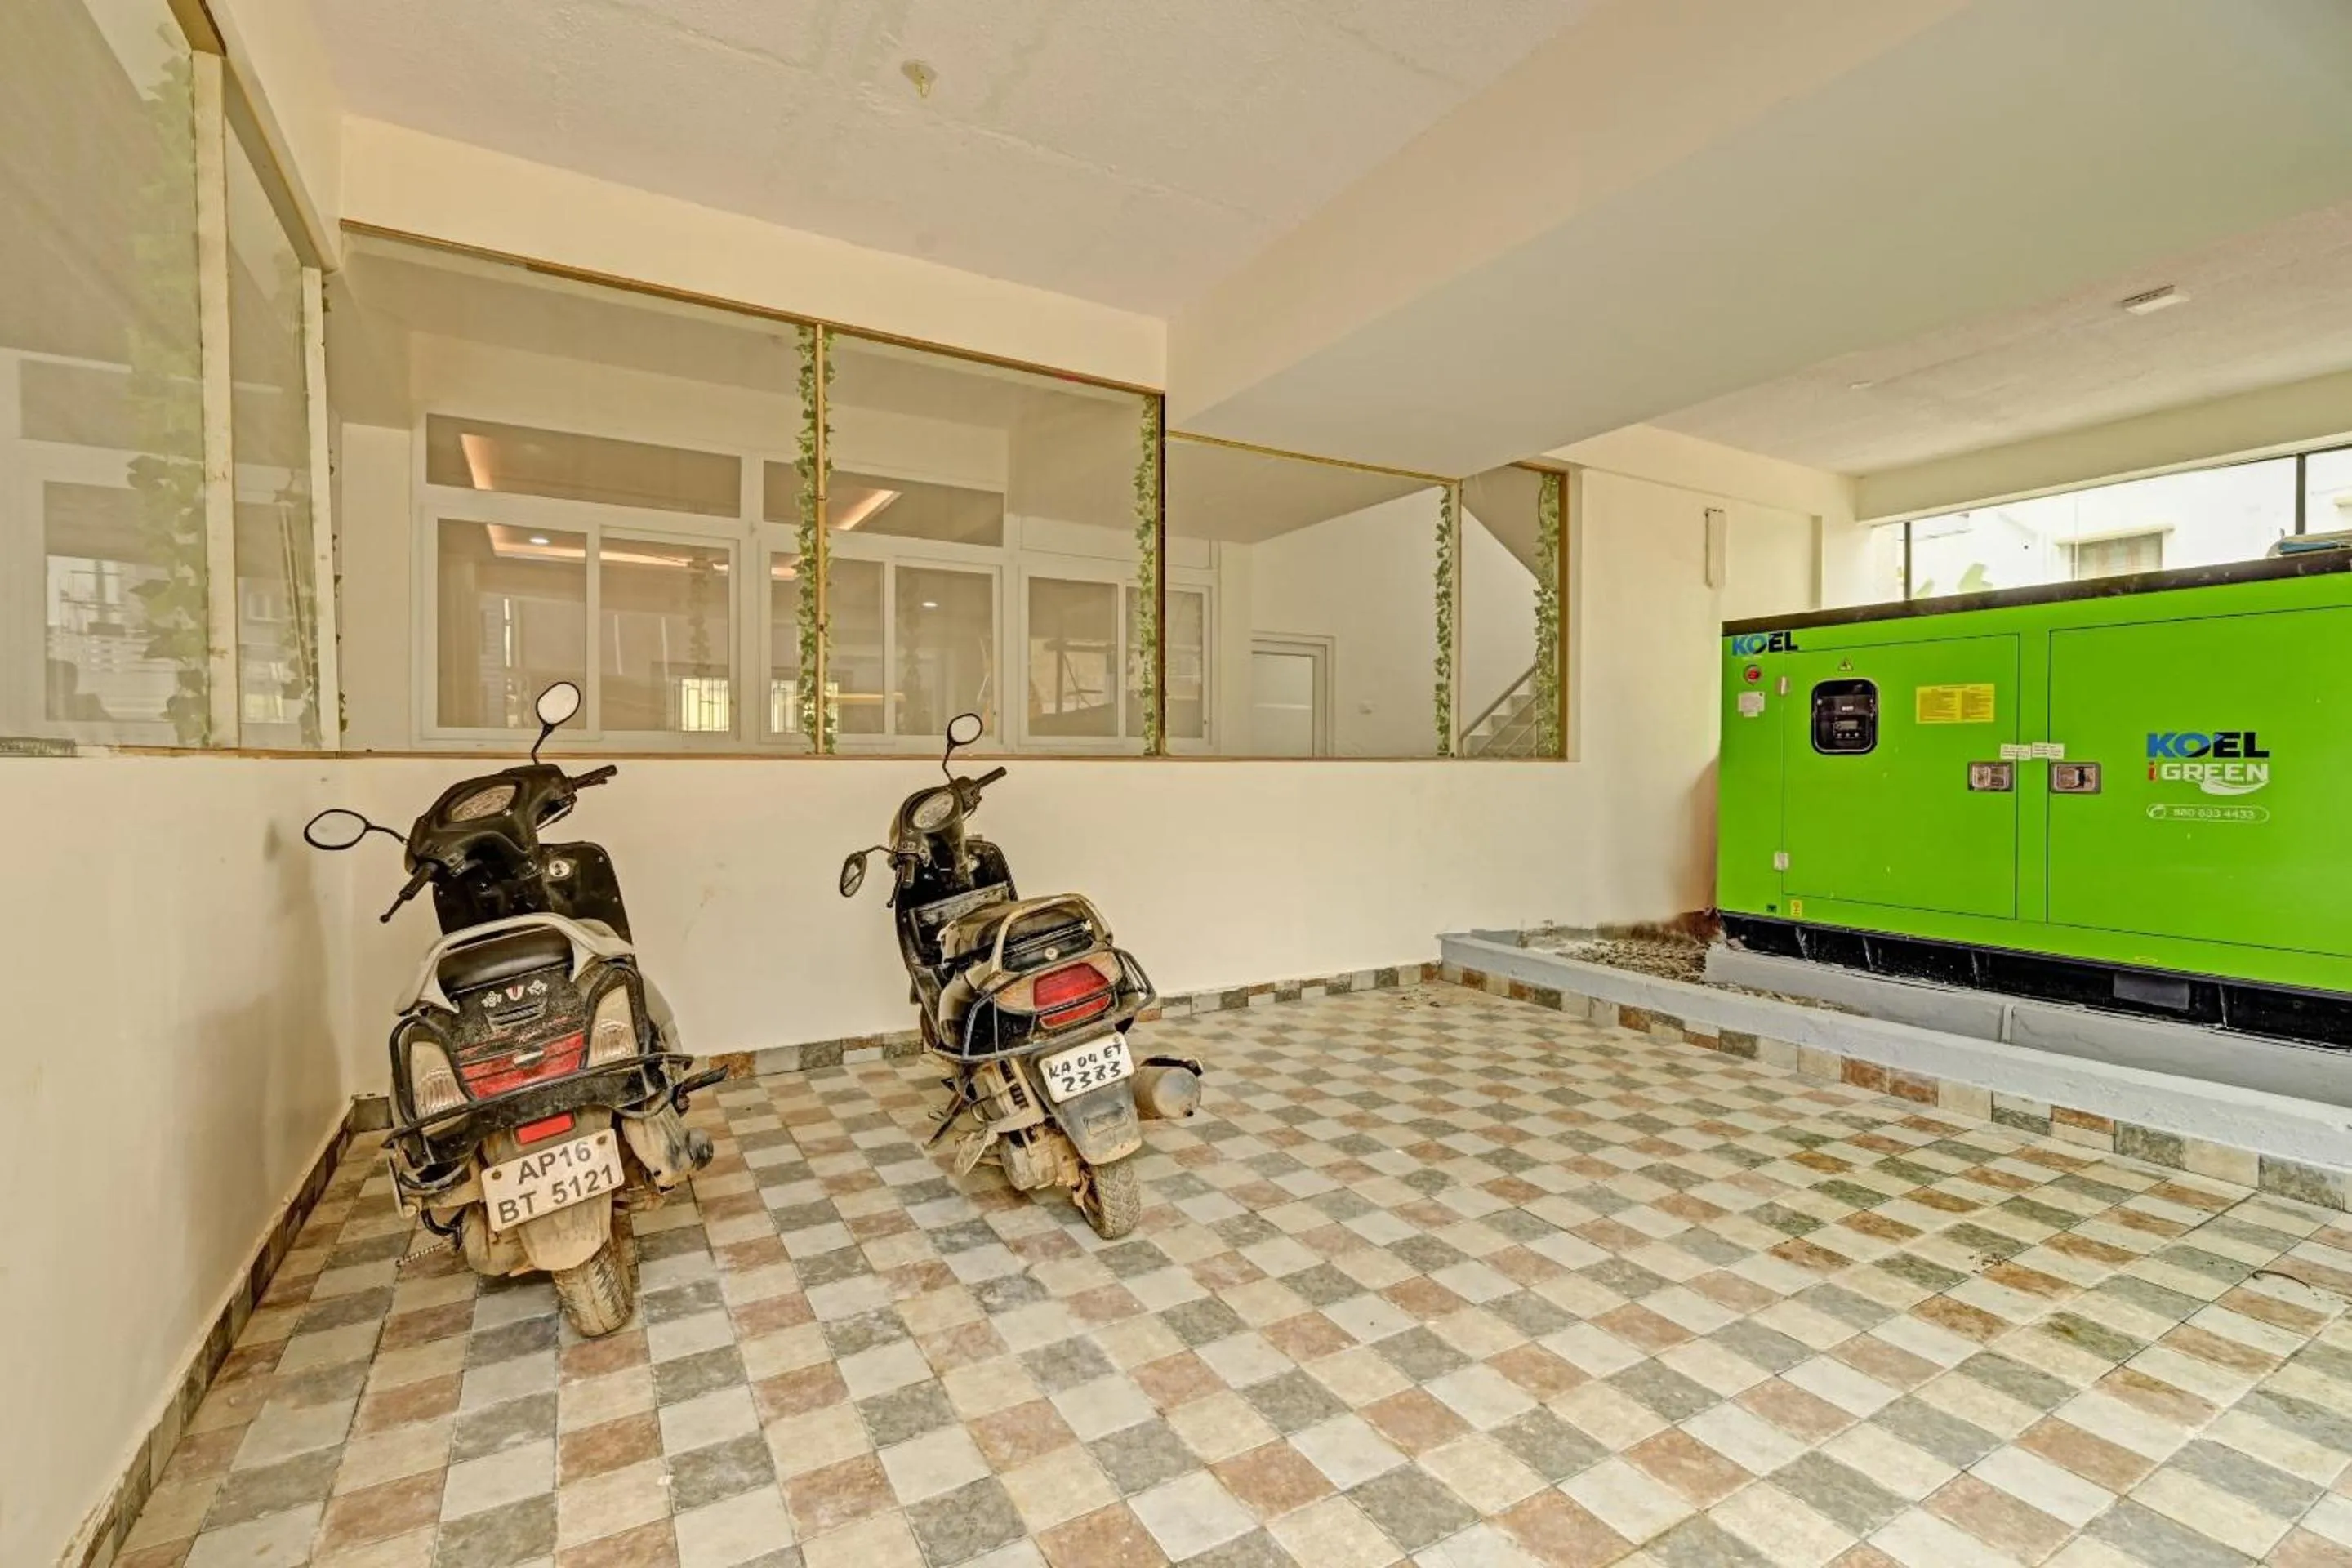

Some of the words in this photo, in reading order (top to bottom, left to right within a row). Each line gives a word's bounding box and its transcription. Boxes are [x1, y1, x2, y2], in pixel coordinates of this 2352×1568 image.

[1732, 631, 1798, 656] KOEL
[2147, 732, 2270, 758] KOEL
[1049, 1061, 1071, 1079] KA
[1103, 1043, 1122, 1059] ET
[1062, 1061, 1122, 1093] 2383
[518, 1141, 591, 1185] AP16
[498, 1190, 537, 1224] BT
[551, 1163, 613, 1205] 5121
